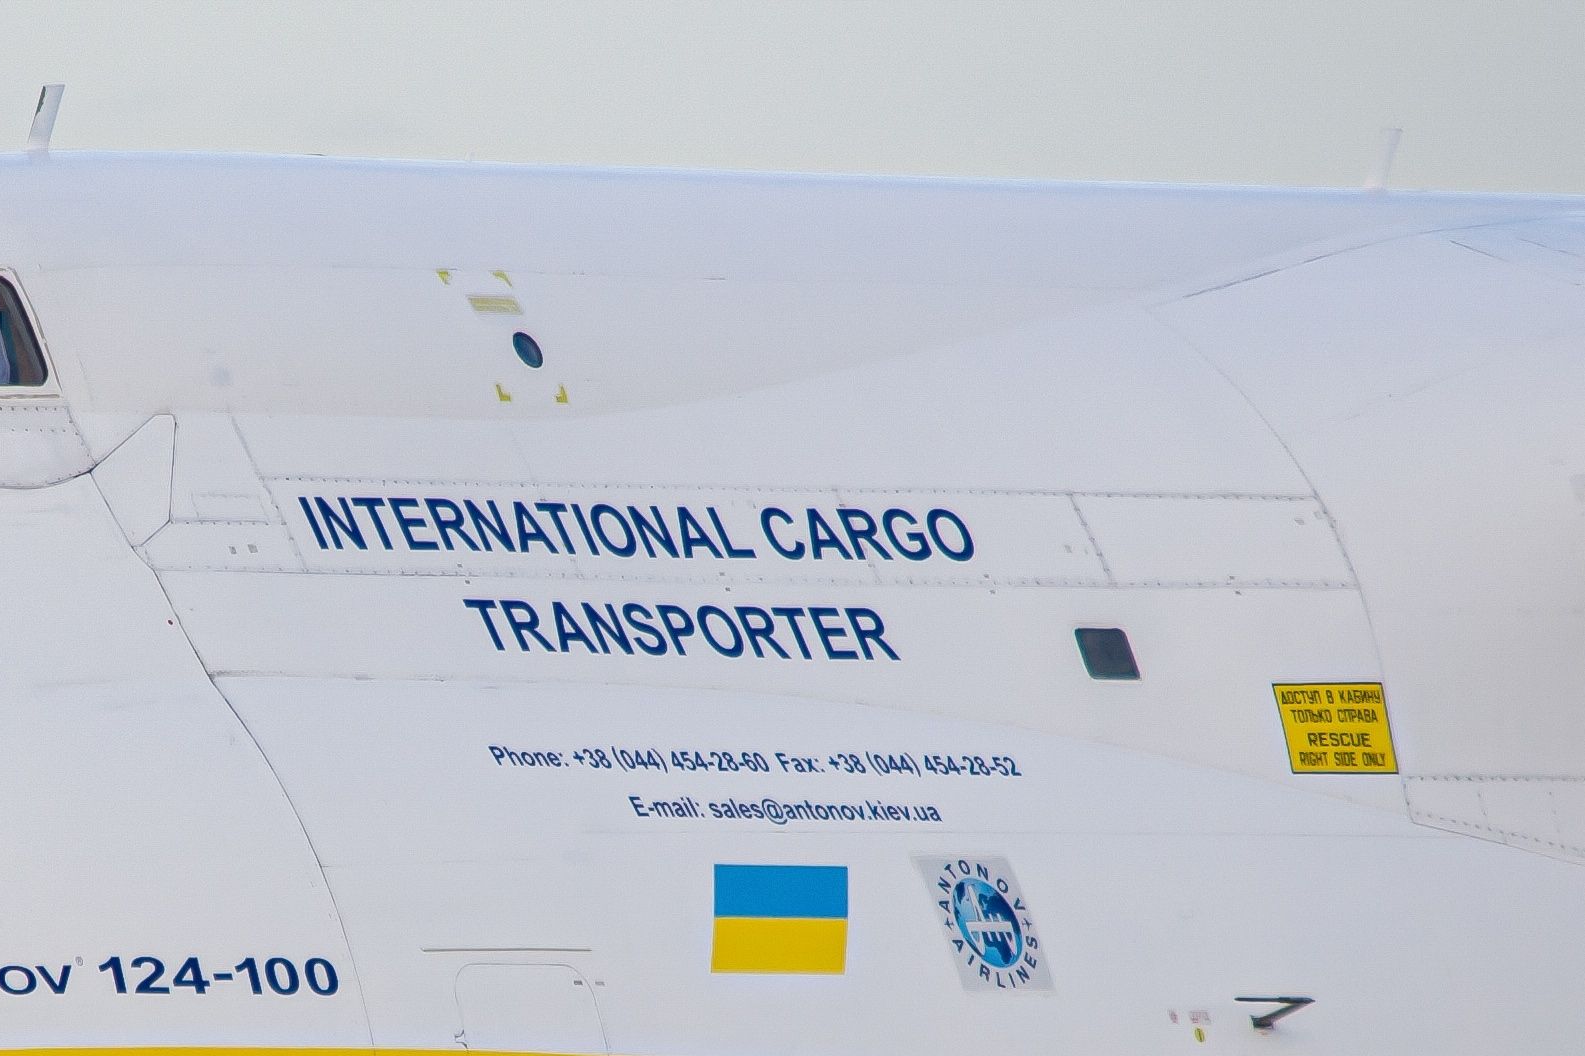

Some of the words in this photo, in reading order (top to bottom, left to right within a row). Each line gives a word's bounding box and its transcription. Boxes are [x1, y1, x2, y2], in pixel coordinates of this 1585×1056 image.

[297, 496, 758, 559] INTERNATIONAL
[760, 506, 975, 562] CARGO
[462, 598, 902, 661] TRANSPORTER
[1281, 690, 1322, 704] ДОСТУП
[1326, 690, 1334, 704] В
[1290, 709, 1332, 723] ТОЛЬКО
[1337, 708, 1378, 723] СПРАВА
[1307, 732, 1372, 747] RESCUE
[487, 745, 569, 768] Phone:
[573, 748, 612, 769] +38
[610, 746, 668, 774] (044)
[671, 750, 770, 773] 454-28-60
[775, 752, 826, 773] Fax:
[829, 753, 867, 774] +38
[865, 751, 922, 778] (044)
[924, 754, 1023, 777] 454-28-52
[1299, 752, 1328, 766] RIGHT
[1334, 752, 1357, 766] SIDE
[1362, 752, 1385, 766] ONLY
[628, 796, 705, 818] E-mail:
[708, 798, 943, 826] sales@antonov.kiev.ua
[938, 859, 1026, 914] ANTONOV
[98, 955, 339, 997] 124-100
[952, 935, 1038, 989] AIRLINES
